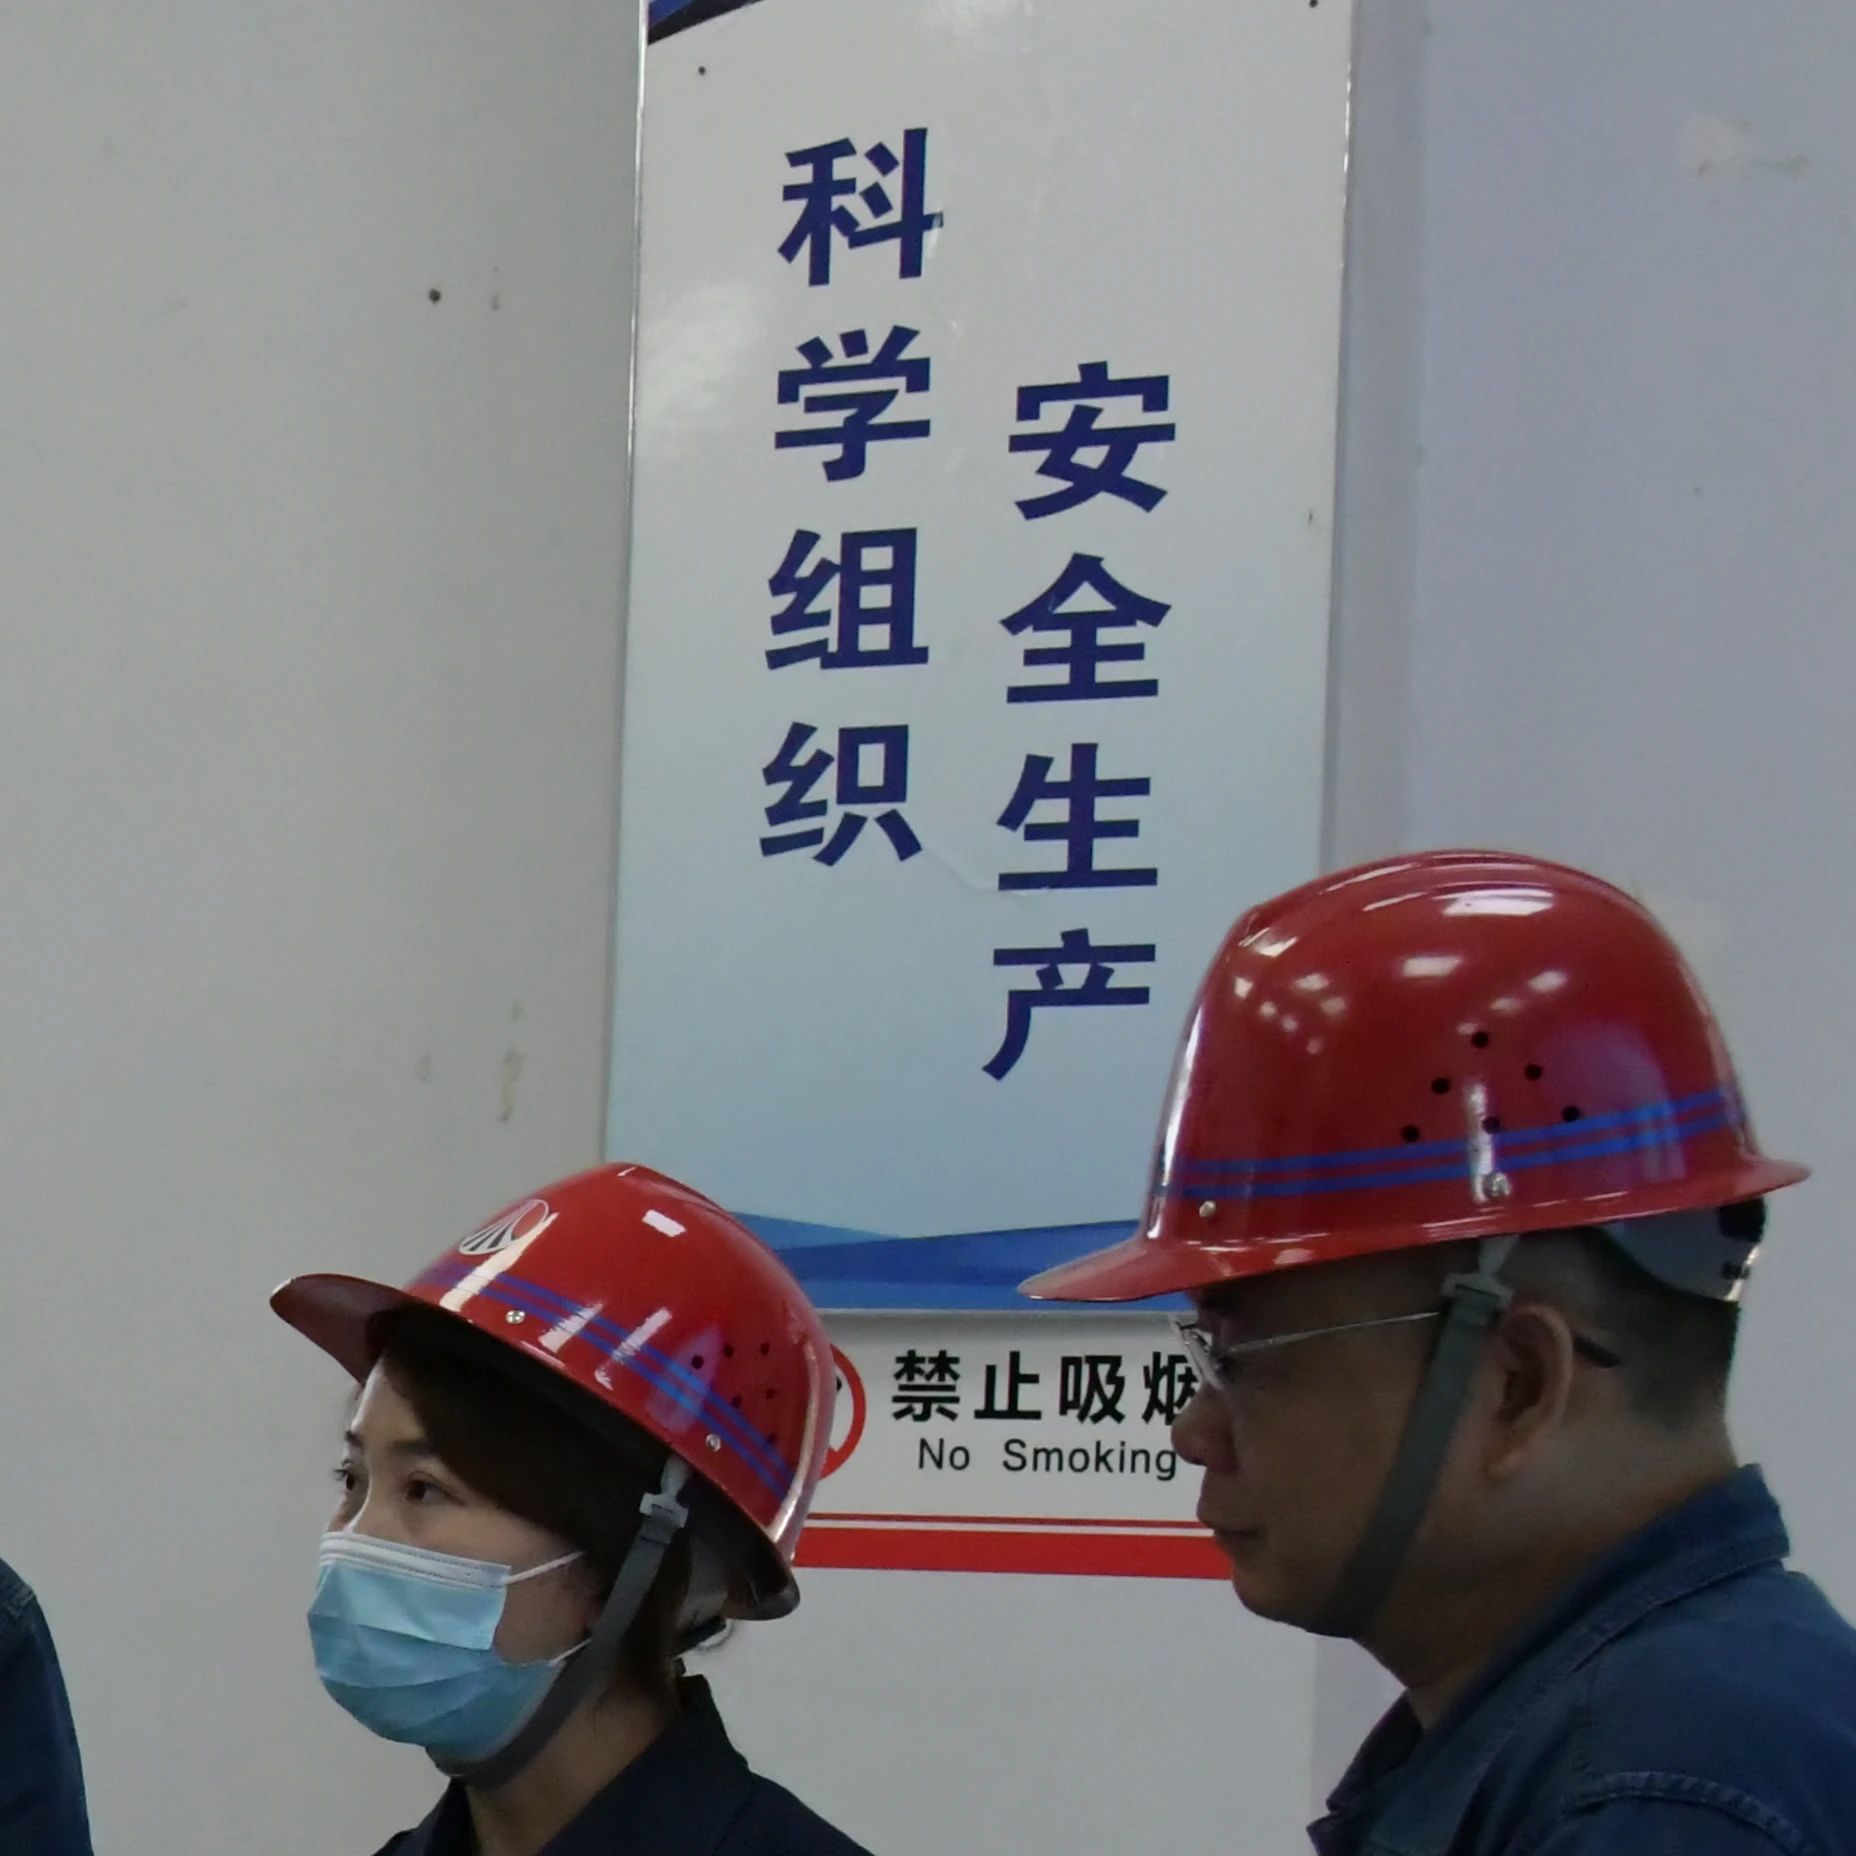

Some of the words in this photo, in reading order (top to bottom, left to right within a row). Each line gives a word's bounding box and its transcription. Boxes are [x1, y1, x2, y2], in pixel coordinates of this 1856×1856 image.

[759, 127, 944, 867] 科学组织
[983, 361, 1177, 1081] 安全生产
[918, 1438, 971, 1471] No
[1003, 1439, 1177, 1481] Smoking
